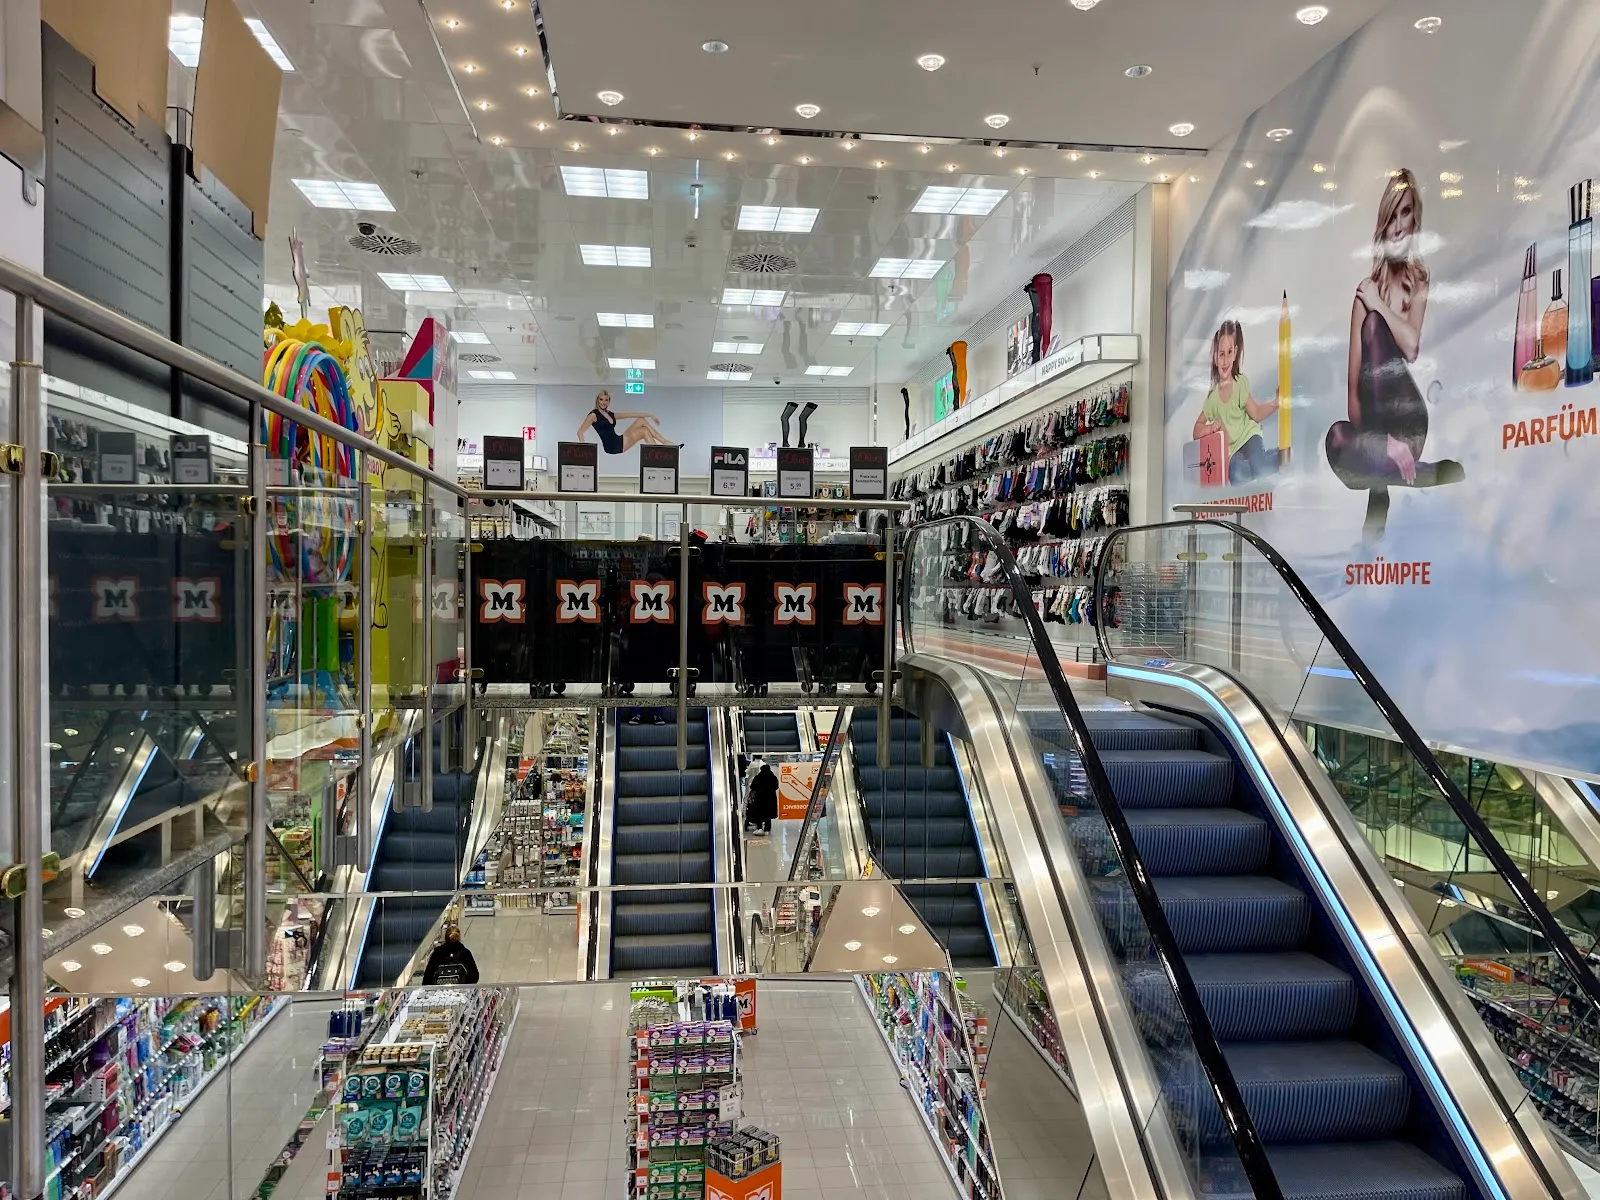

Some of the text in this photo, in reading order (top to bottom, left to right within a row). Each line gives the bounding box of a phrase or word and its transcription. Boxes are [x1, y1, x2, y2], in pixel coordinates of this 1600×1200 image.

[1041, 359, 1058, 376] HAPPY
[1502, 403, 1598, 450] PARFÜM
[714, 452, 746, 465] FILA
[1345, 557, 1430, 585] STRÜMPFE
